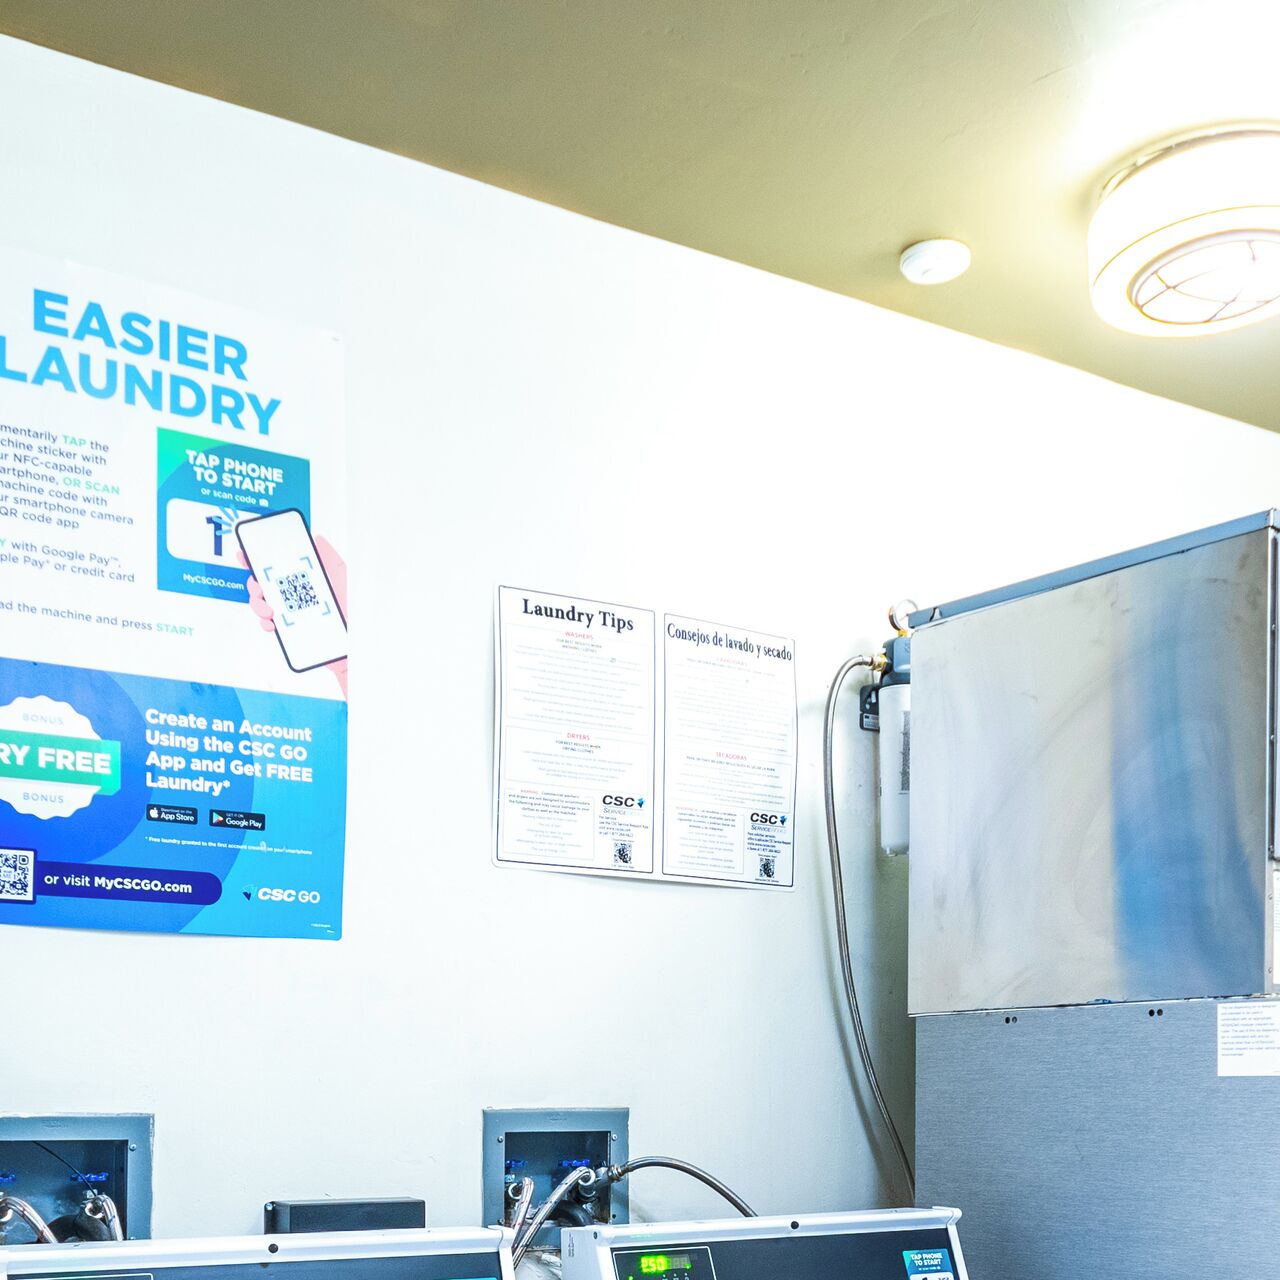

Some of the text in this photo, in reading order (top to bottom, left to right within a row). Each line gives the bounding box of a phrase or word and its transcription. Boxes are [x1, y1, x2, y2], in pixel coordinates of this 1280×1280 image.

[34, 288, 248, 381] EASIER
[62, 434, 87, 447] TAP
[90, 440, 109, 453] the
[13, 453, 93, 477] NFC-capable
[38, 444, 107, 466] sticker with
[185, 449, 284, 483] TAP PHONE
[63, 477, 120, 495] OR SCAN
[193, 466, 277, 496] TO START
[48, 489, 78, 502] code
[82, 494, 107, 507] with
[213, 489, 233, 500] scan
[234, 493, 257, 505] code
[13, 496, 134, 525] smartphone camera
[22, 511, 53, 525] code
[56, 518, 80, 530] app
[205, 516, 223, 556] 1
[11, 541, 85, 562] with Google
[54, 563, 66, 571] or
[71, 565, 105, 578] credit
[109, 570, 135, 583] card
[17, 602, 195, 637] the machine and press START
[522, 598, 635, 633] Laundry Tips
[667, 622, 792, 661] Consejos de lavado y secado
[22, 712, 64, 726] BONUS
[145, 708, 313, 742] Create an Account
[145, 730, 308, 762] Using the CSC GO
[567, 732, 590, 741] DRYERS
[38, 747, 112, 775] FREE
[145, 751, 313, 783] App and Get FREE
[22, 791, 64, 804] BONUS
[602, 794, 635, 808] CSC
[160, 811, 195, 823] App Store
[225, 817, 263, 829] Google Play
[750, 812, 778, 825] CSC
[44, 873, 193, 894] or visit MyCSCGO.com
[258, 887, 321, 904] CSC GO
